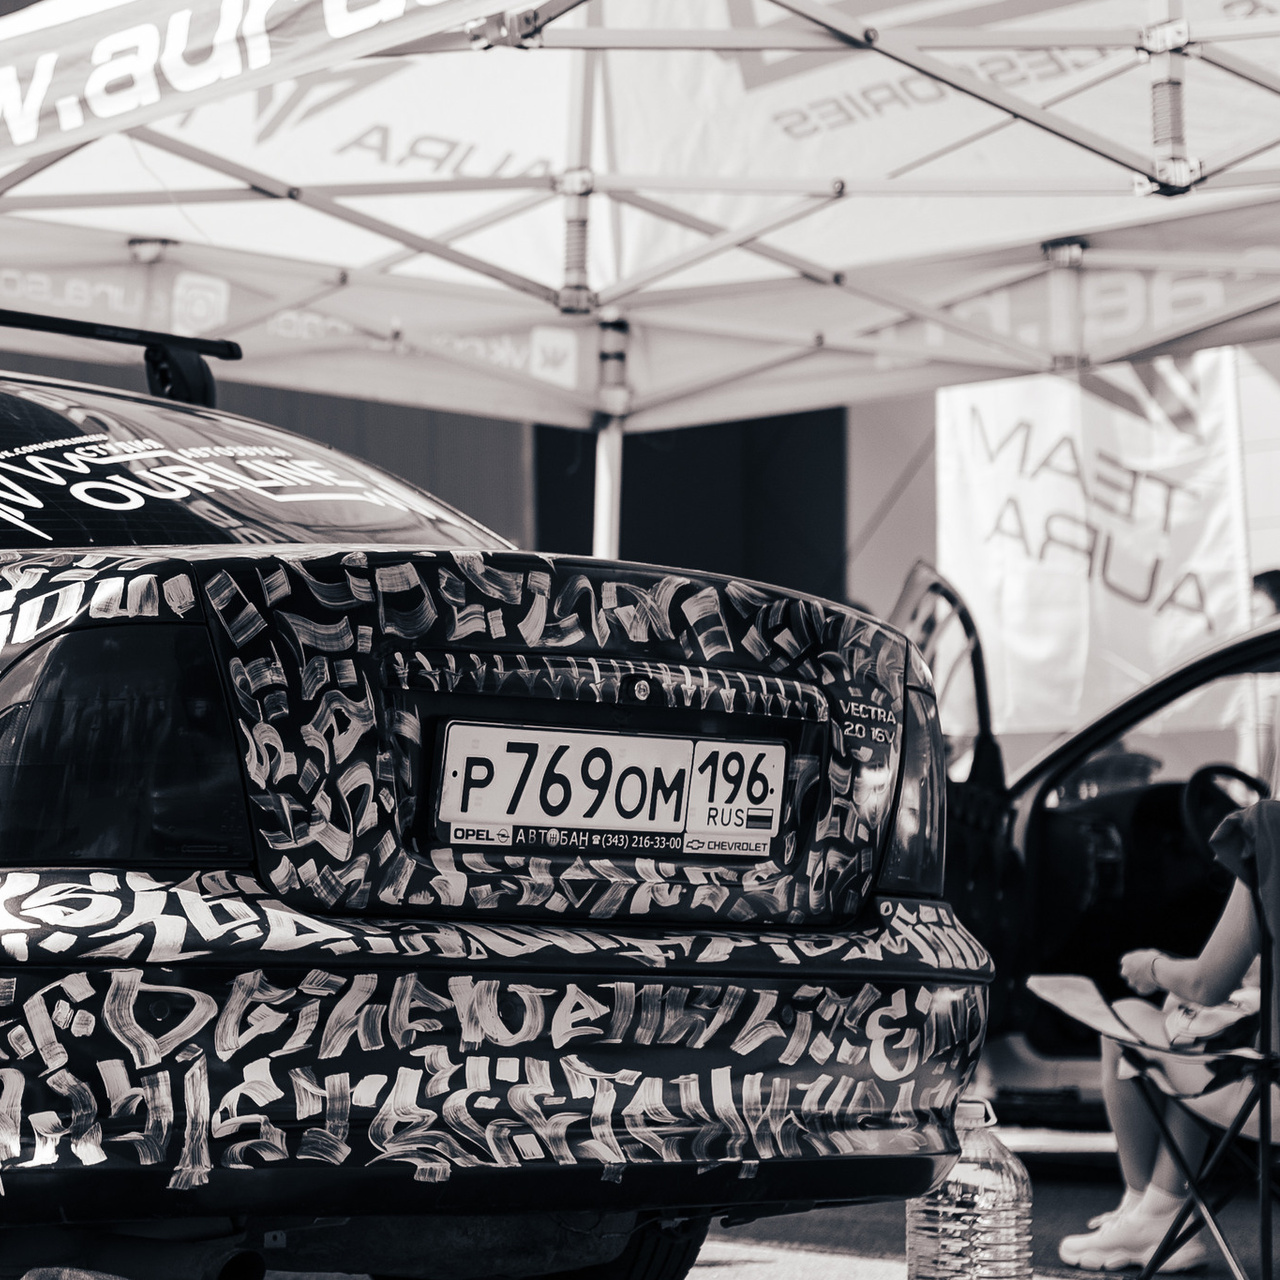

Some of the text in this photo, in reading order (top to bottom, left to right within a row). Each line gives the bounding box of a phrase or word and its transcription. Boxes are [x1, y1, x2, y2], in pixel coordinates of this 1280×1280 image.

[839, 699, 897, 725] VECTRA
[870, 726, 896, 744] 16V
[459, 740, 770, 823] P769OM 196
[706, 807, 745, 827] RUS
[453, 828, 495, 842] OPEL
[601, 833, 629, 849] (343)
[631, 833, 682, 850] 216-33-00
[706, 839, 769, 853] CHEVROLET
